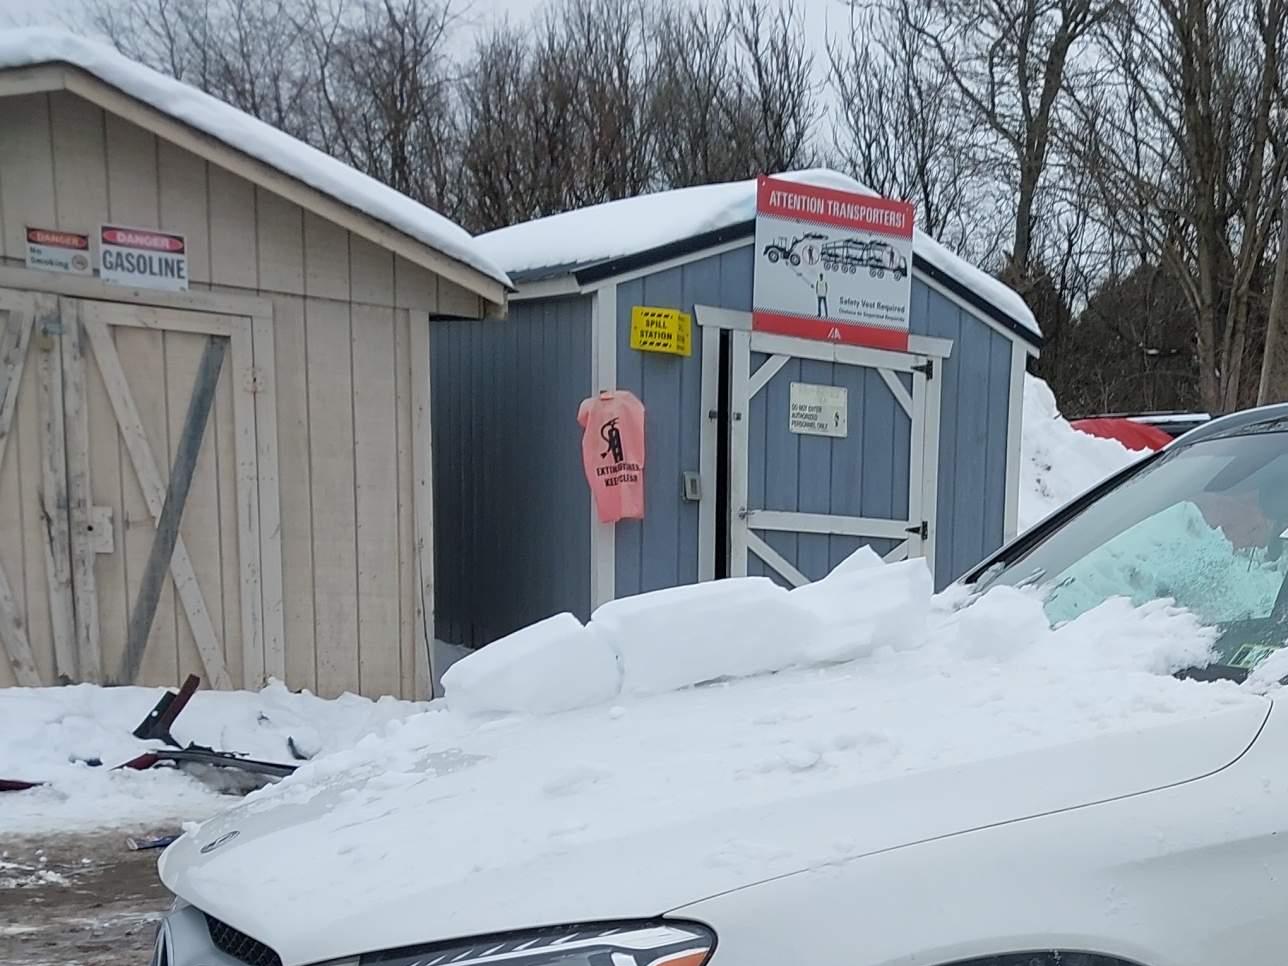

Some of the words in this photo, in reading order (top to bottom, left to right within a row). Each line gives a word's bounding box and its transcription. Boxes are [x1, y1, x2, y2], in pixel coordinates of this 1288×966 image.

[769, 190, 824, 215] ATTENTION
[827, 200, 905, 228] TRANSPORTERS!
[37, 231, 79, 246] DANGER
[116, 230, 170, 249] DANGER
[102, 249, 185, 279] GASOLINE
[839, 297, 860, 308] Safety
[860, 299, 876, 309] Vest
[876, 301, 905, 313] Required
[645, 319, 667, 329] SPILL
[640, 330, 672, 340] STATION
